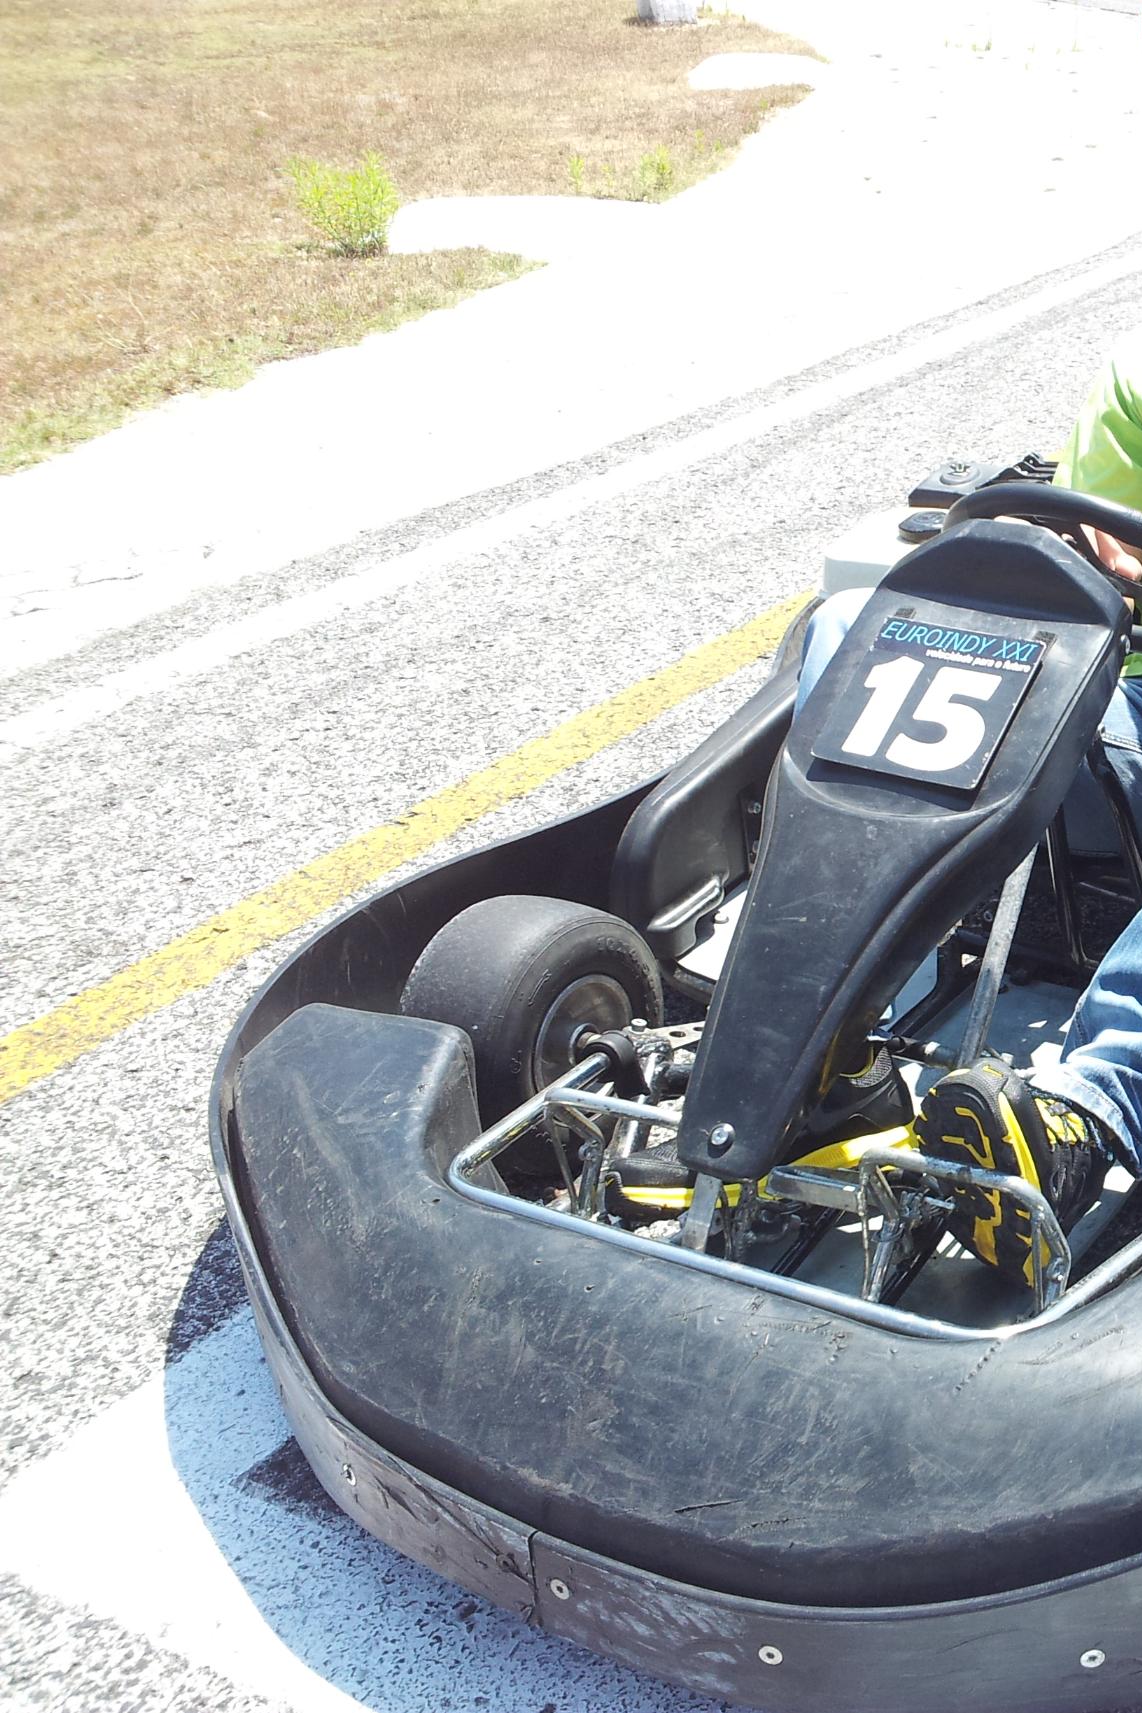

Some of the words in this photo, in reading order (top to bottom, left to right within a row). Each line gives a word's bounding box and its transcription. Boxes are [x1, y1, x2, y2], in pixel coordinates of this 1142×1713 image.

[880, 621, 996, 655] EUROINDY
[996, 639, 1040, 662] XXI
[925, 648, 974, 665] velocidade
[972, 656, 995, 668] para
[995, 660, 1003, 669] o
[1003, 660, 1031, 673] futuro
[841, 655, 1002, 772] 15
